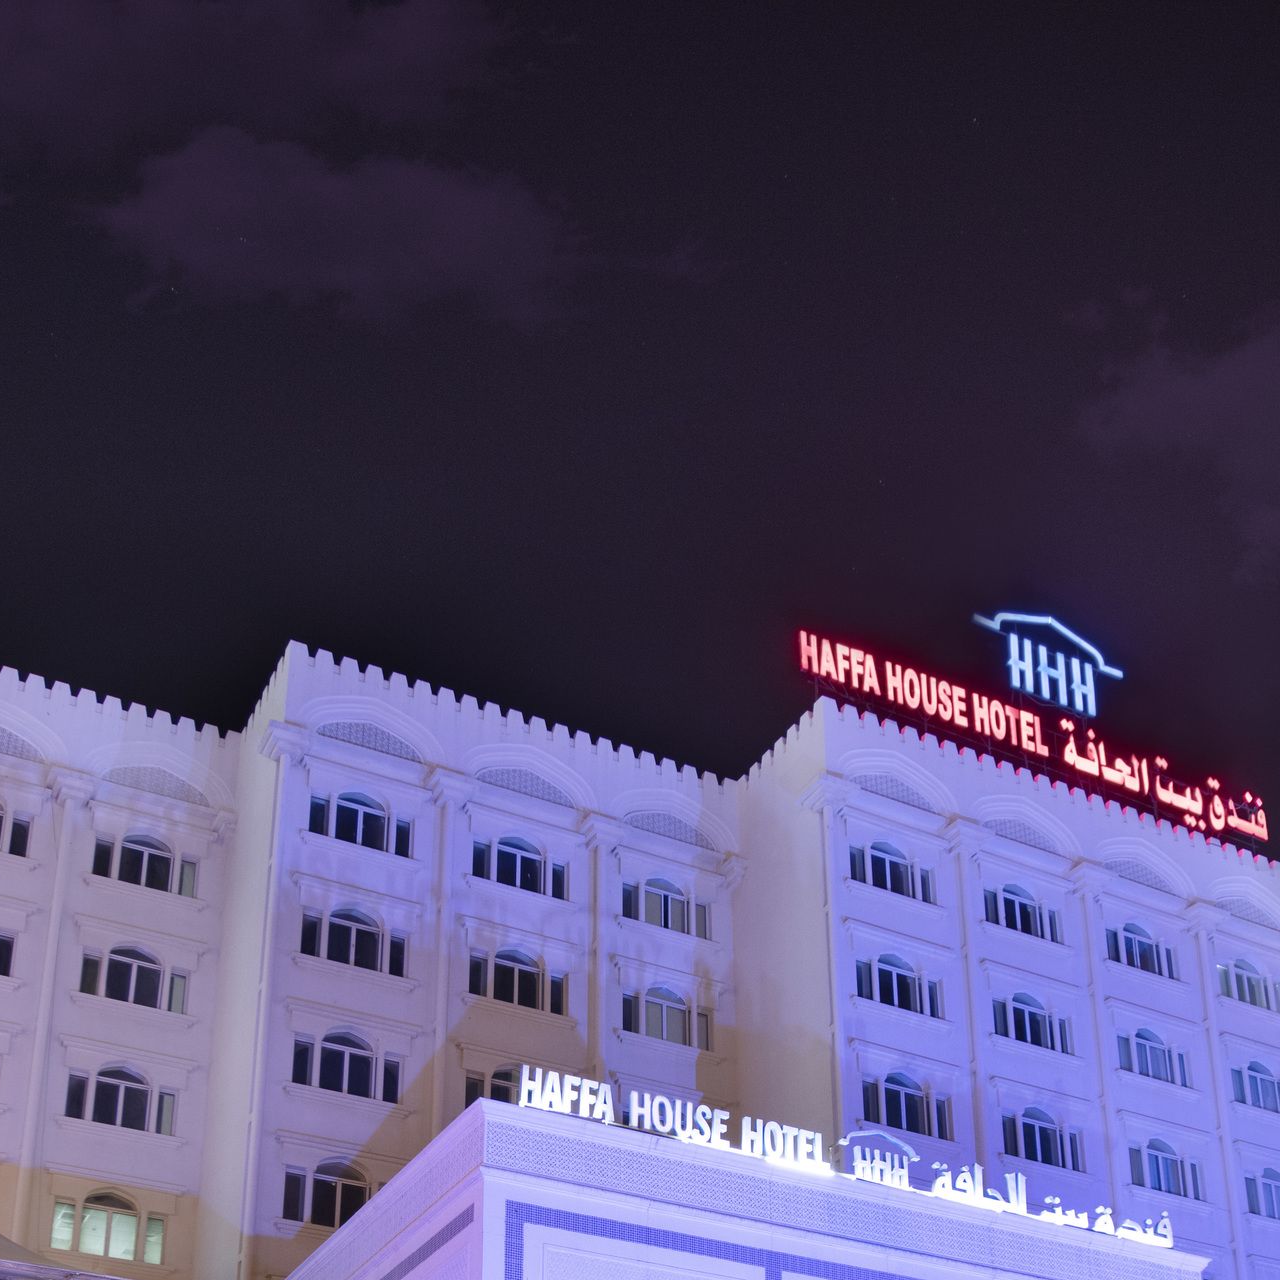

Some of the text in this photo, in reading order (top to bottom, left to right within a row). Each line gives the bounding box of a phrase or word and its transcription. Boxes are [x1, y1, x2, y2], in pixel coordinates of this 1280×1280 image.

[799, 630, 1049, 757] HAFFA HOUSE HOTEL
[1006, 633, 1096, 717] HHH
[1060, 718, 1269, 841] فندق بيت الحافة
[520, 1064, 831, 1173] HAFFA HOUSE HOTEL
[853, 1145, 909, 1189] HHH
